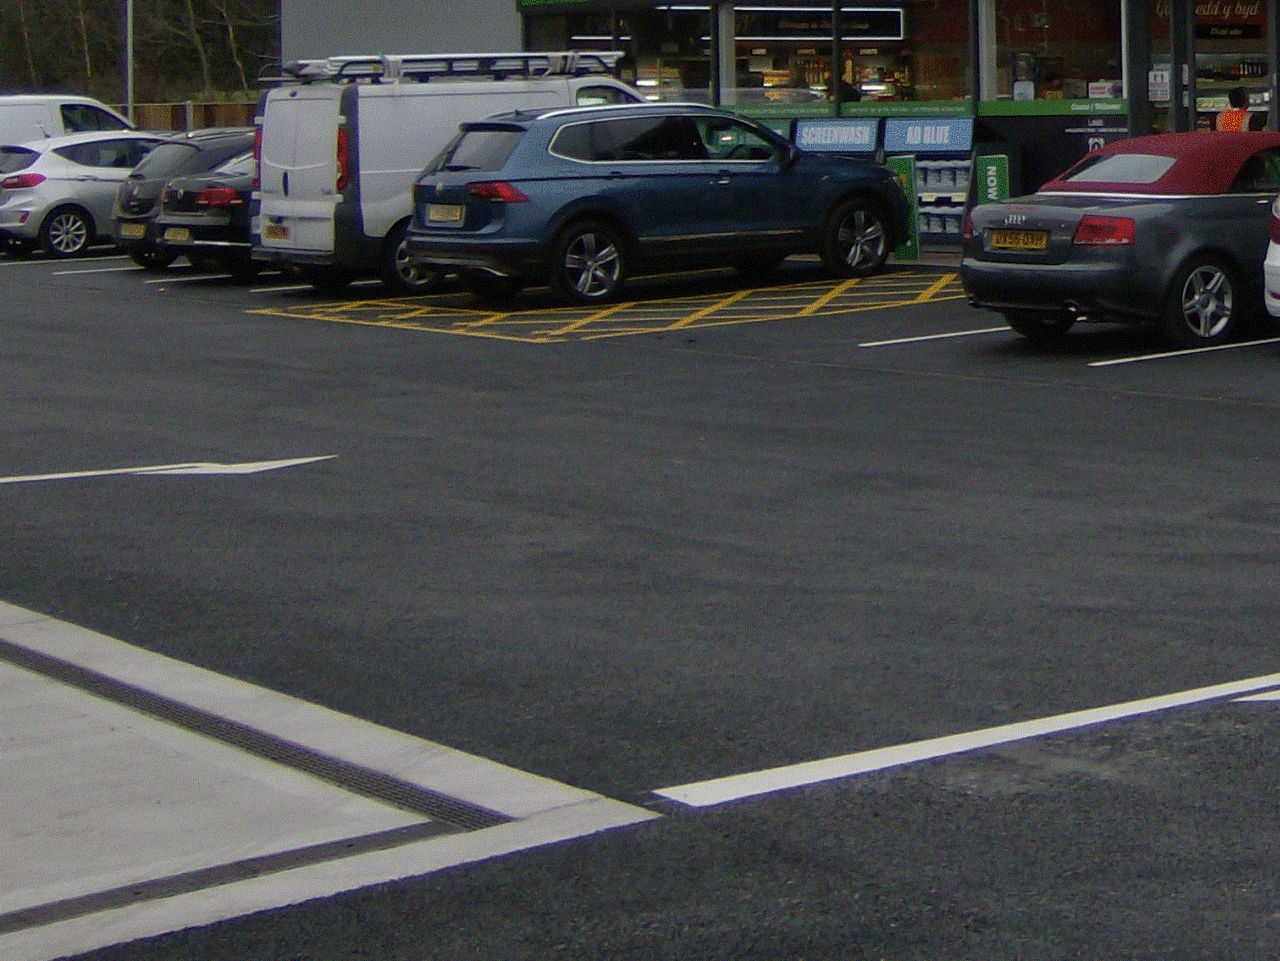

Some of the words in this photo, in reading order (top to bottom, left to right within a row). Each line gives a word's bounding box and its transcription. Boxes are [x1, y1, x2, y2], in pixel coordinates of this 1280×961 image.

[801, 126, 869, 144] SCREENWASH
[906, 126, 921, 144] AD
[922, 126, 950, 144] BLUE
[986, 166, 998, 199] NOW
